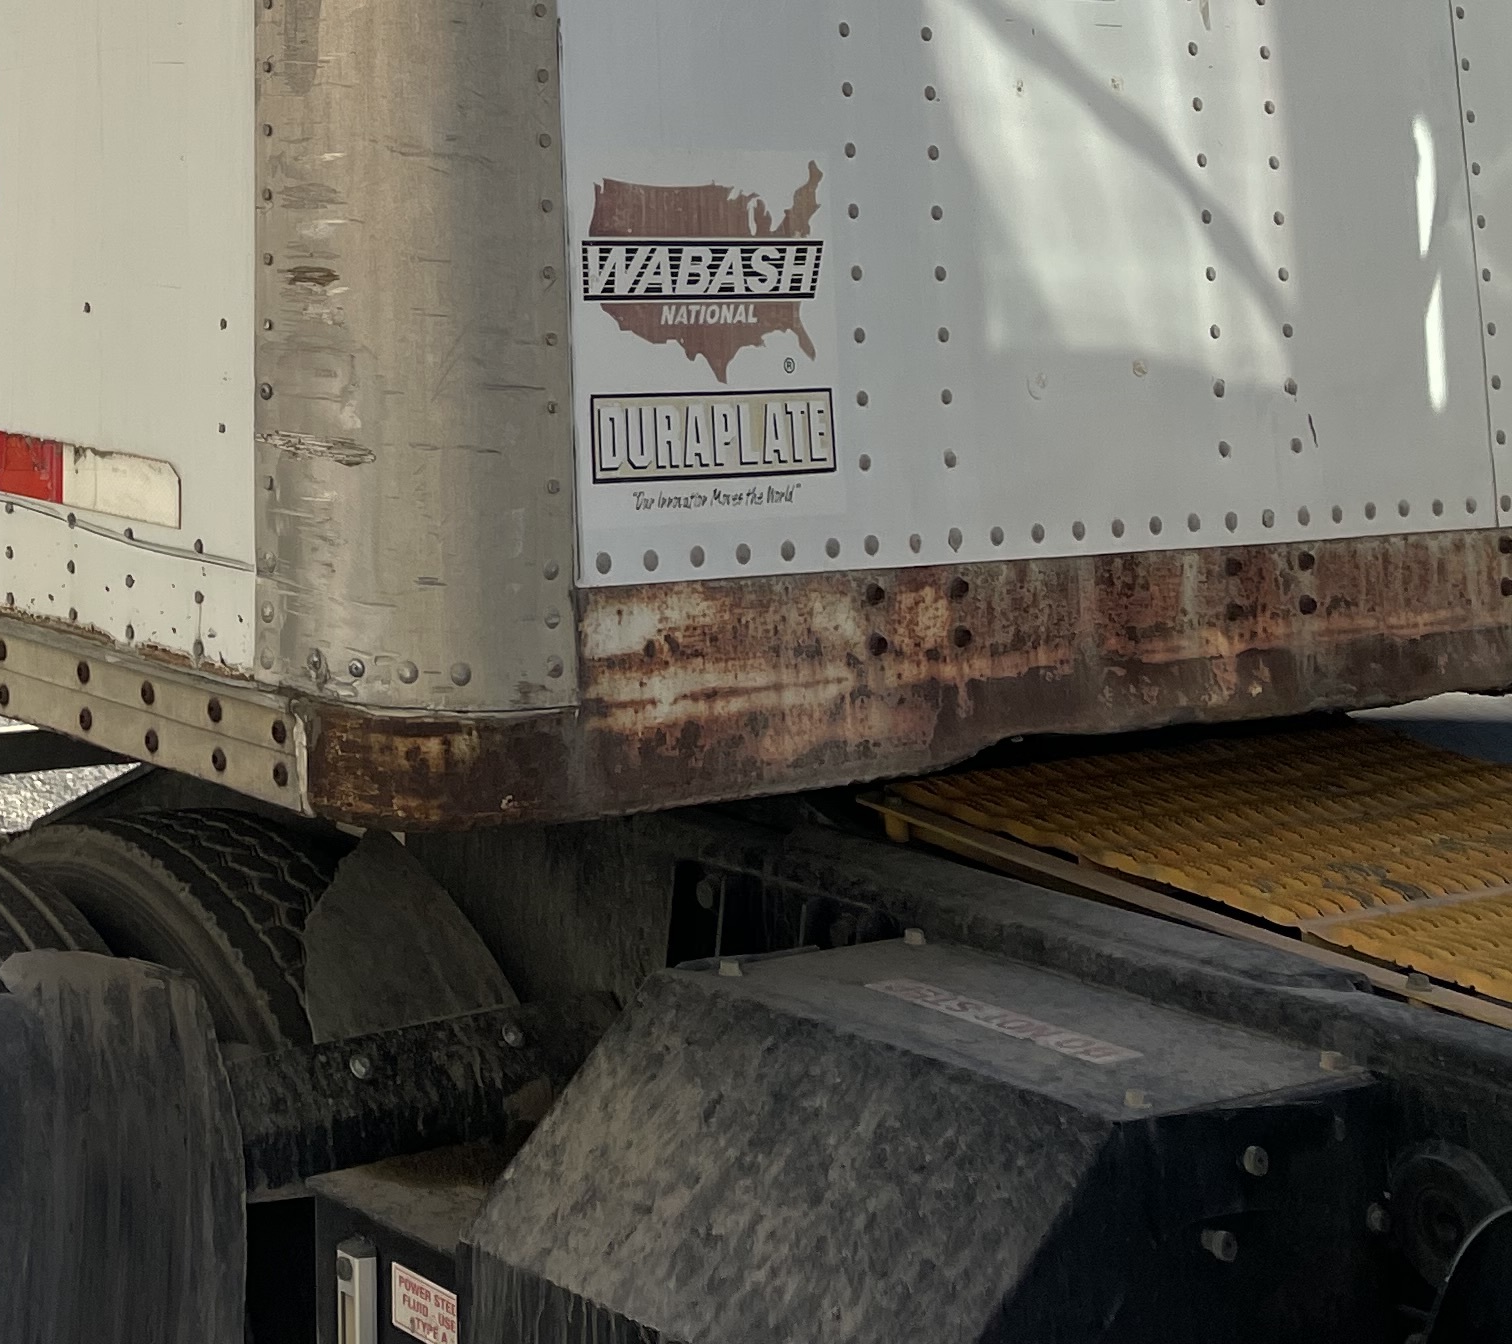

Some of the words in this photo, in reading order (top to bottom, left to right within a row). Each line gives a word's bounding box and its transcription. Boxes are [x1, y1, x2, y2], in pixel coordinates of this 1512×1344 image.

[588, 245, 822, 295] WABASH
[660, 303, 758, 326] NATIONAL
[597, 400, 829, 473] DURAPLATE
[398, 1274, 431, 1303] POWER
[402, 1293, 429, 1318] FLUID
[415, 1317, 439, 1340] TYPE
